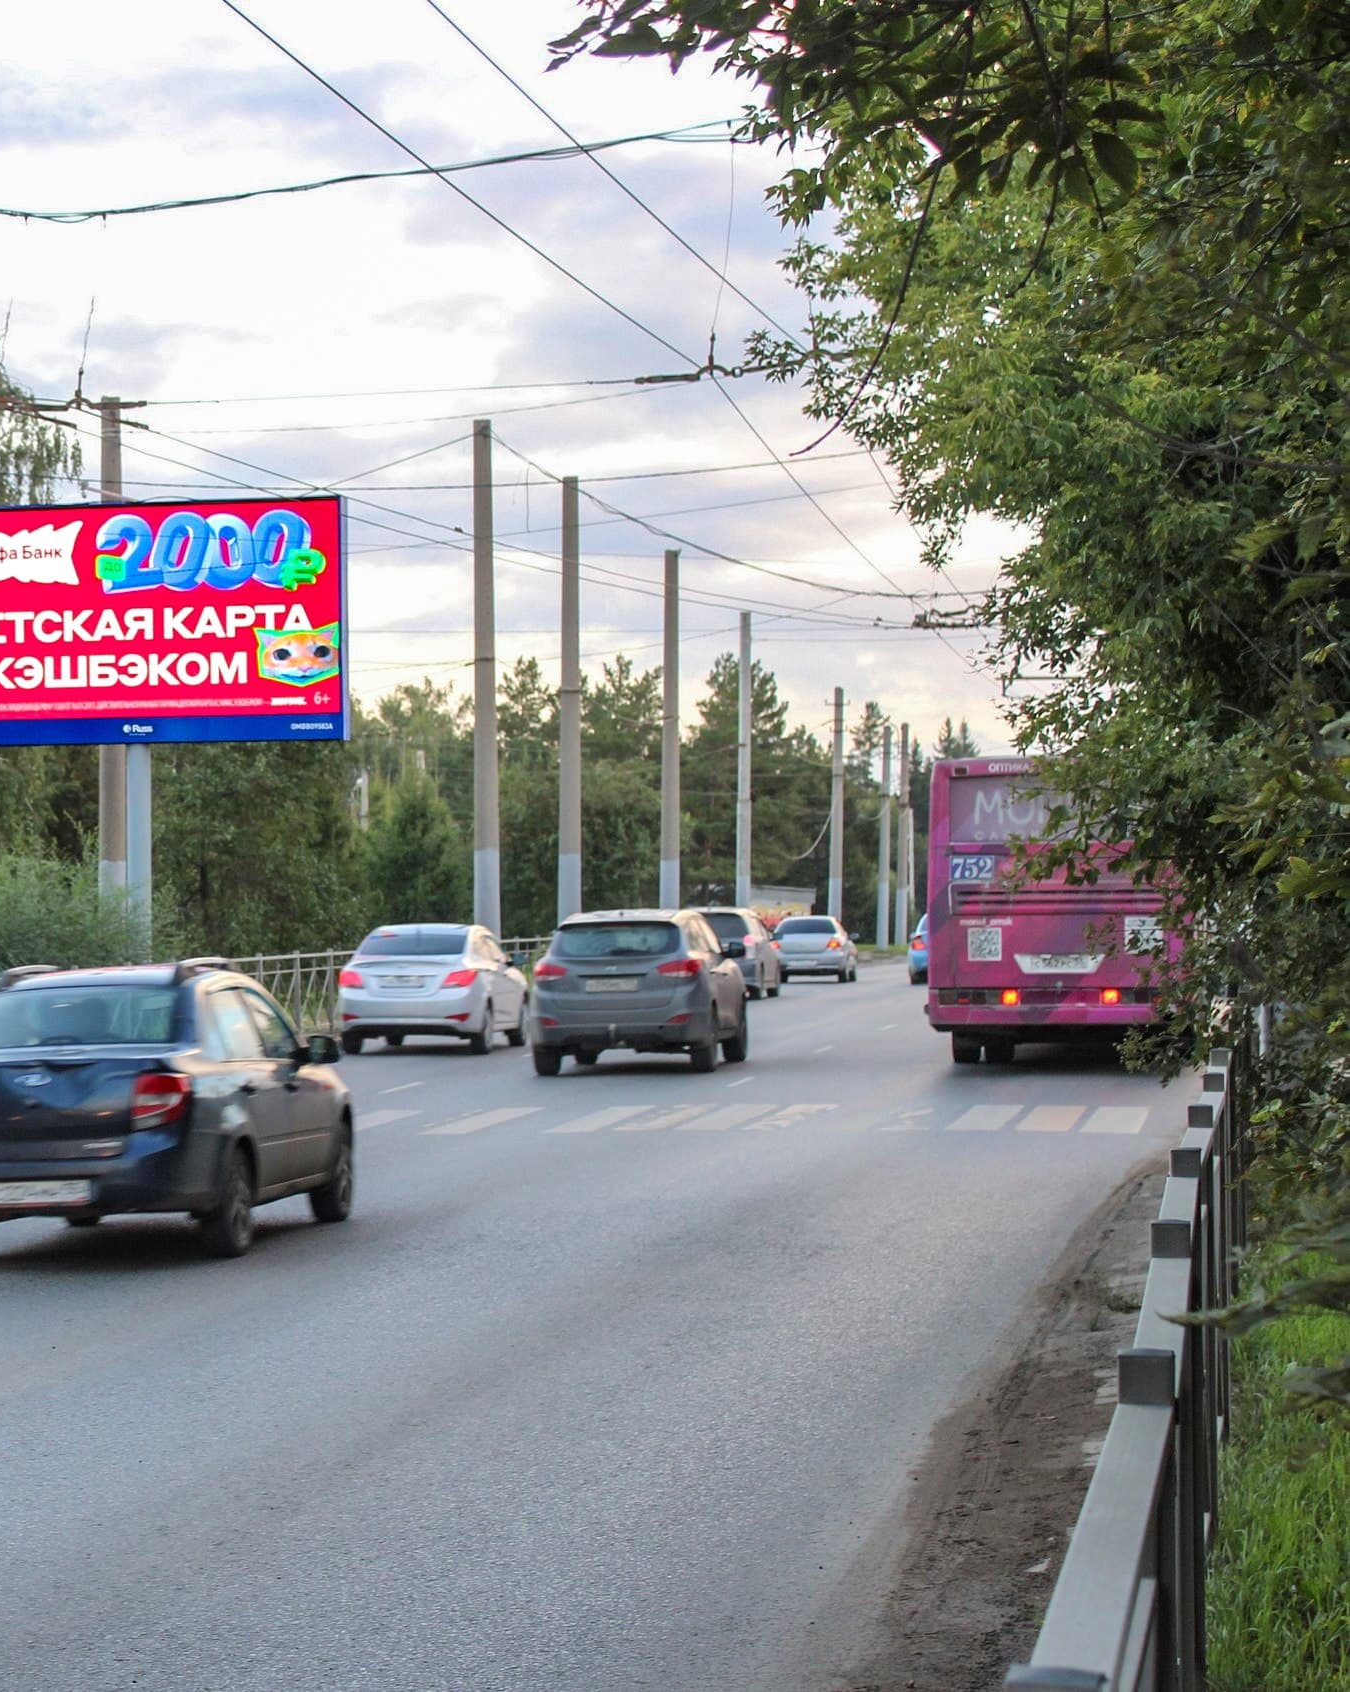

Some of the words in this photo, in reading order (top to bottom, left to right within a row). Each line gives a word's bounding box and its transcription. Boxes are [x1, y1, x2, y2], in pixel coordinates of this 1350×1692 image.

[22, 544, 63, 560] Банк
[163, 604, 312, 640] КАРТА
[313, 691, 330, 705] 6+
[952, 857, 993, 879] 752
